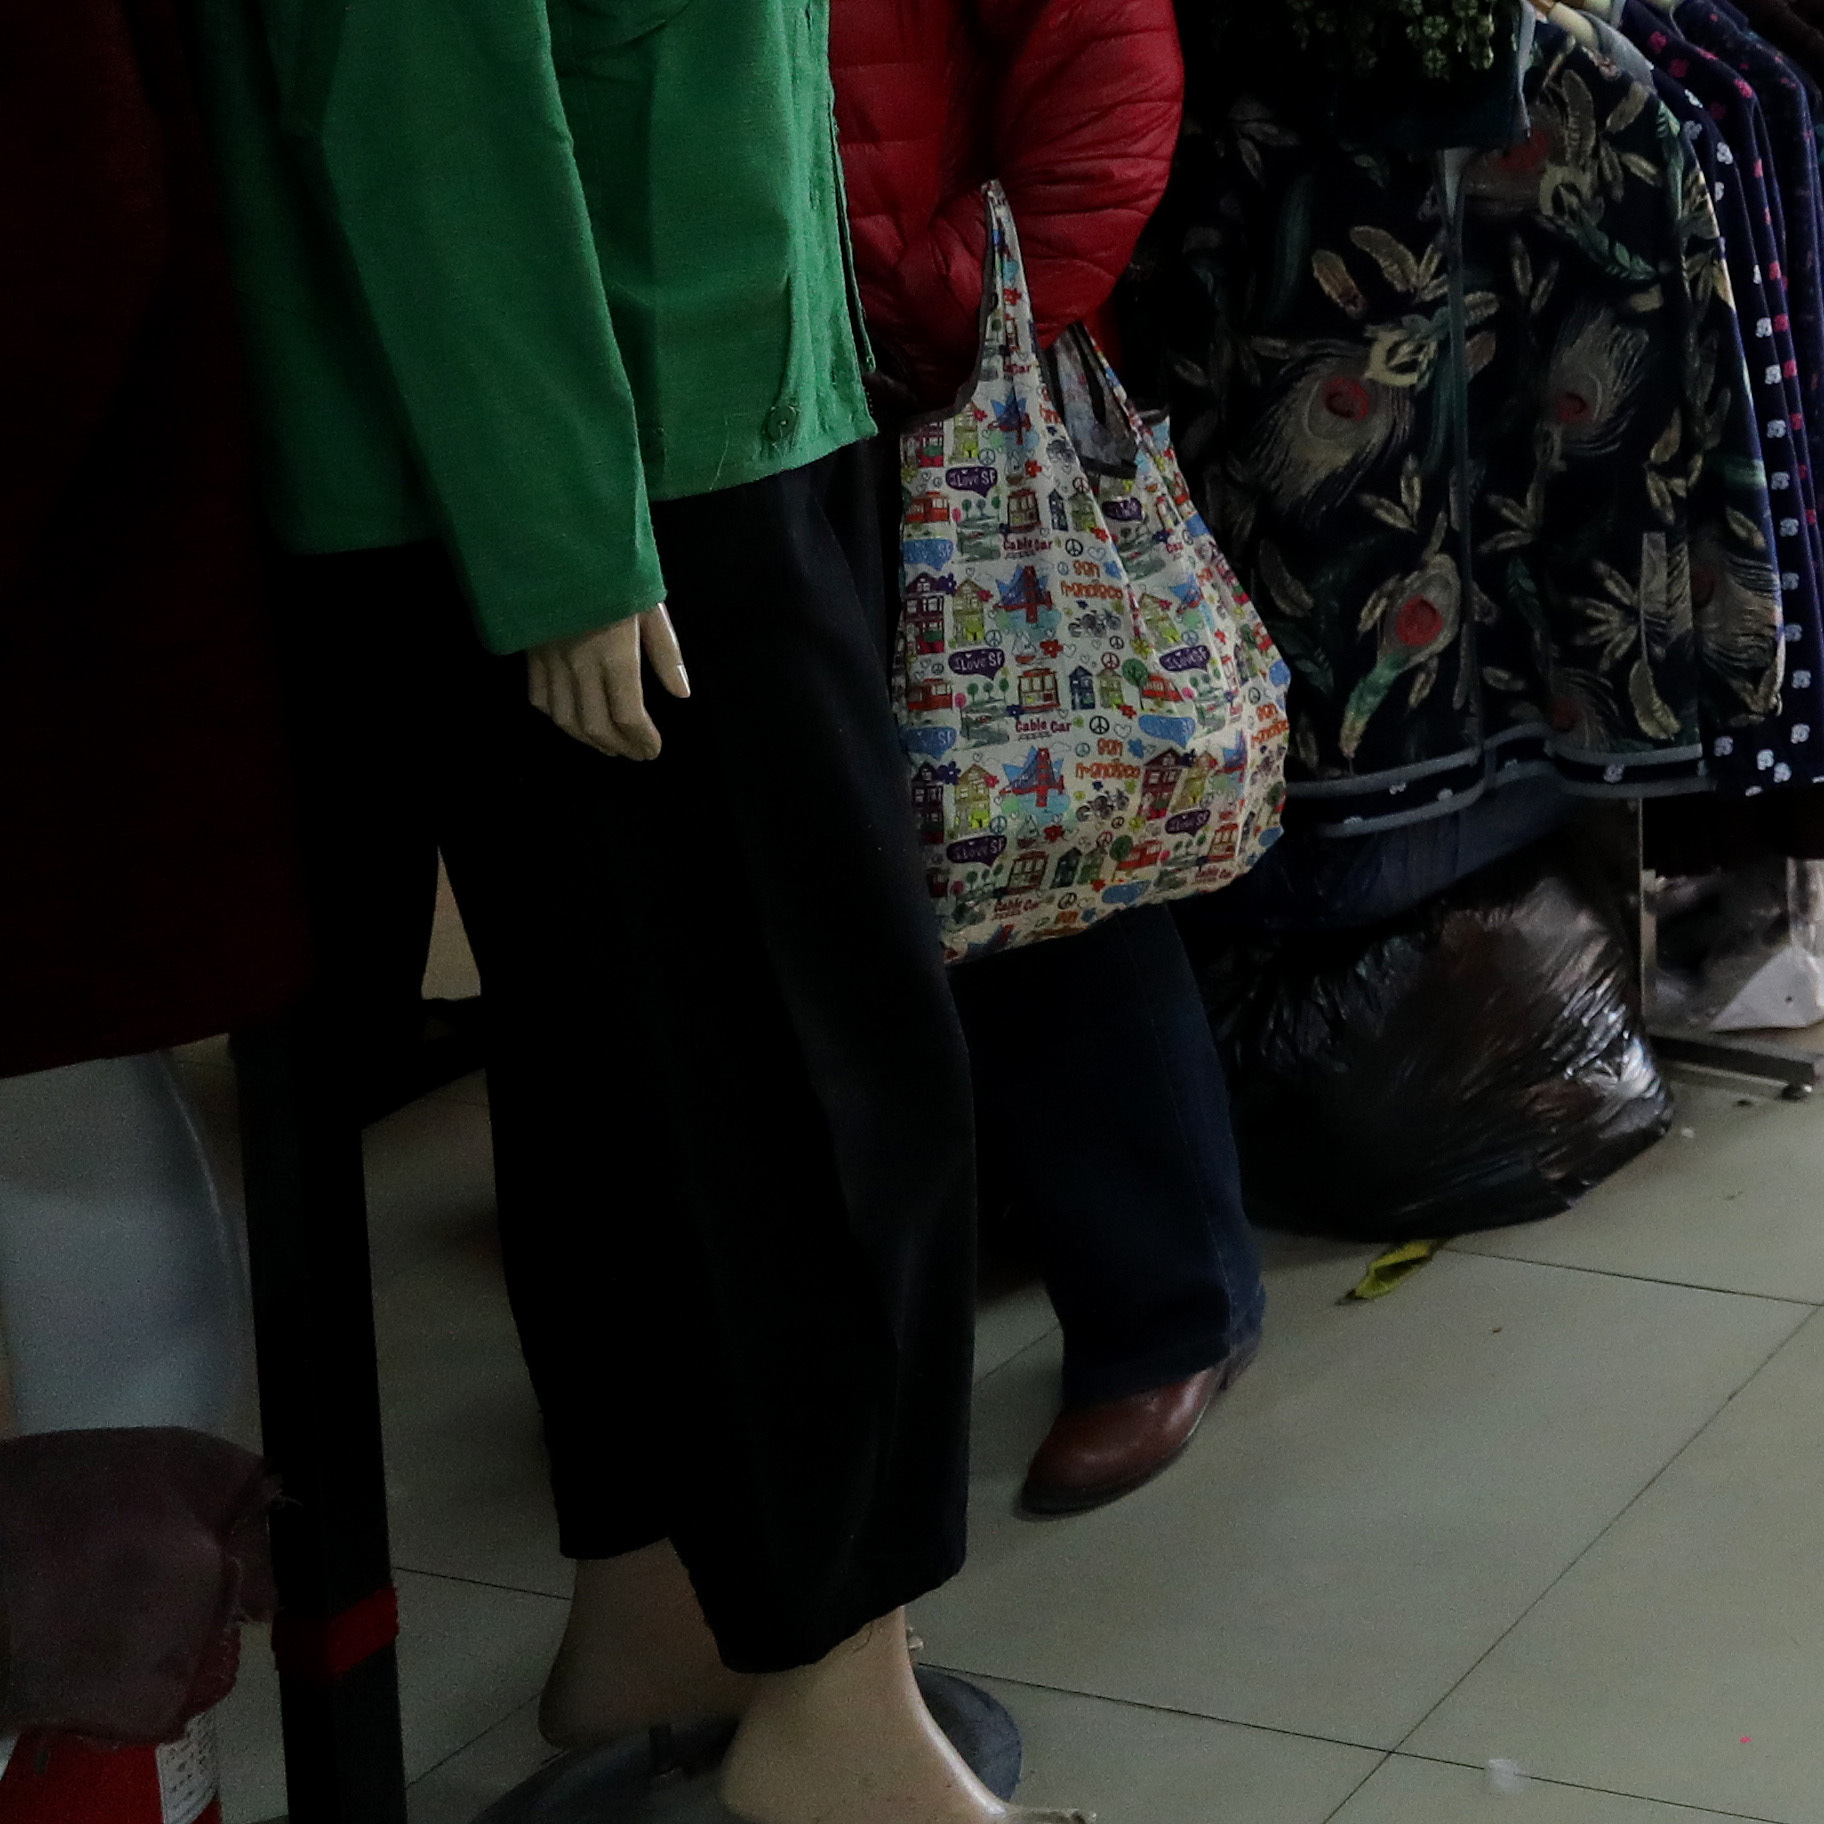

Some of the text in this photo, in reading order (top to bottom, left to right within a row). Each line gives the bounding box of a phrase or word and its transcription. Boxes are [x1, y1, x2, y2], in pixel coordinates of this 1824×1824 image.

[980, 470, 996, 485] SF
[961, 657, 986, 670] Love
[988, 651, 1002, 667] SF
[1015, 718, 1072, 733] Cable Car
